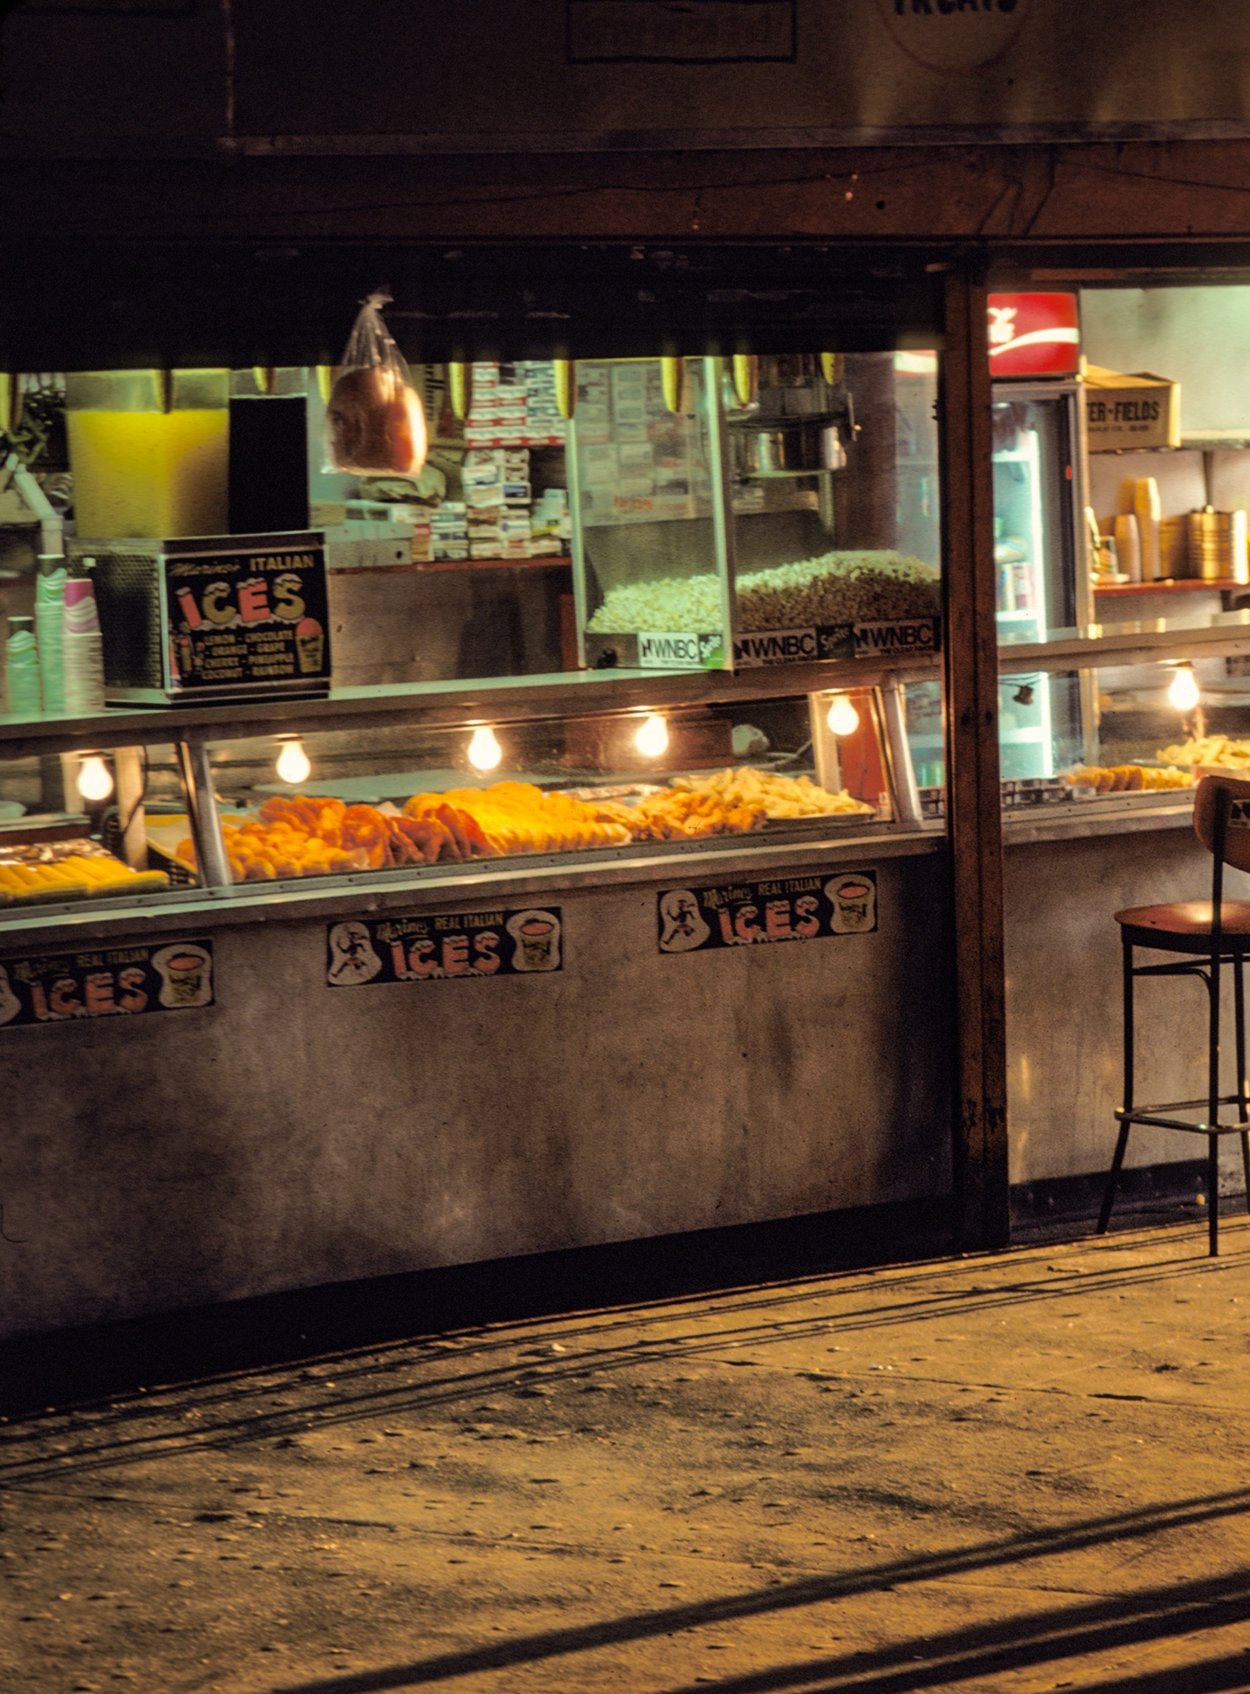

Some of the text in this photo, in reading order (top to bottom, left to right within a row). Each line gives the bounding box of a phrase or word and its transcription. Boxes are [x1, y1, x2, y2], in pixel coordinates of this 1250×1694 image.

[250, 555, 315, 572] ITALIAN
[174, 573, 306, 630] ICES
[751, 634, 815, 658] WNBC
[870, 623, 933, 647] WNBC
[652, 638, 698, 659] WNBC
[758, 882, 783, 897] REAL
[784, 877, 822, 894] ITALIAN
[434, 916, 461, 931] REAL
[463, 911, 504, 928] ITALIAN
[718, 895, 820, 944] ICES
[391, 931, 501, 980] ICES
[29, 966, 149, 1019] ICES
